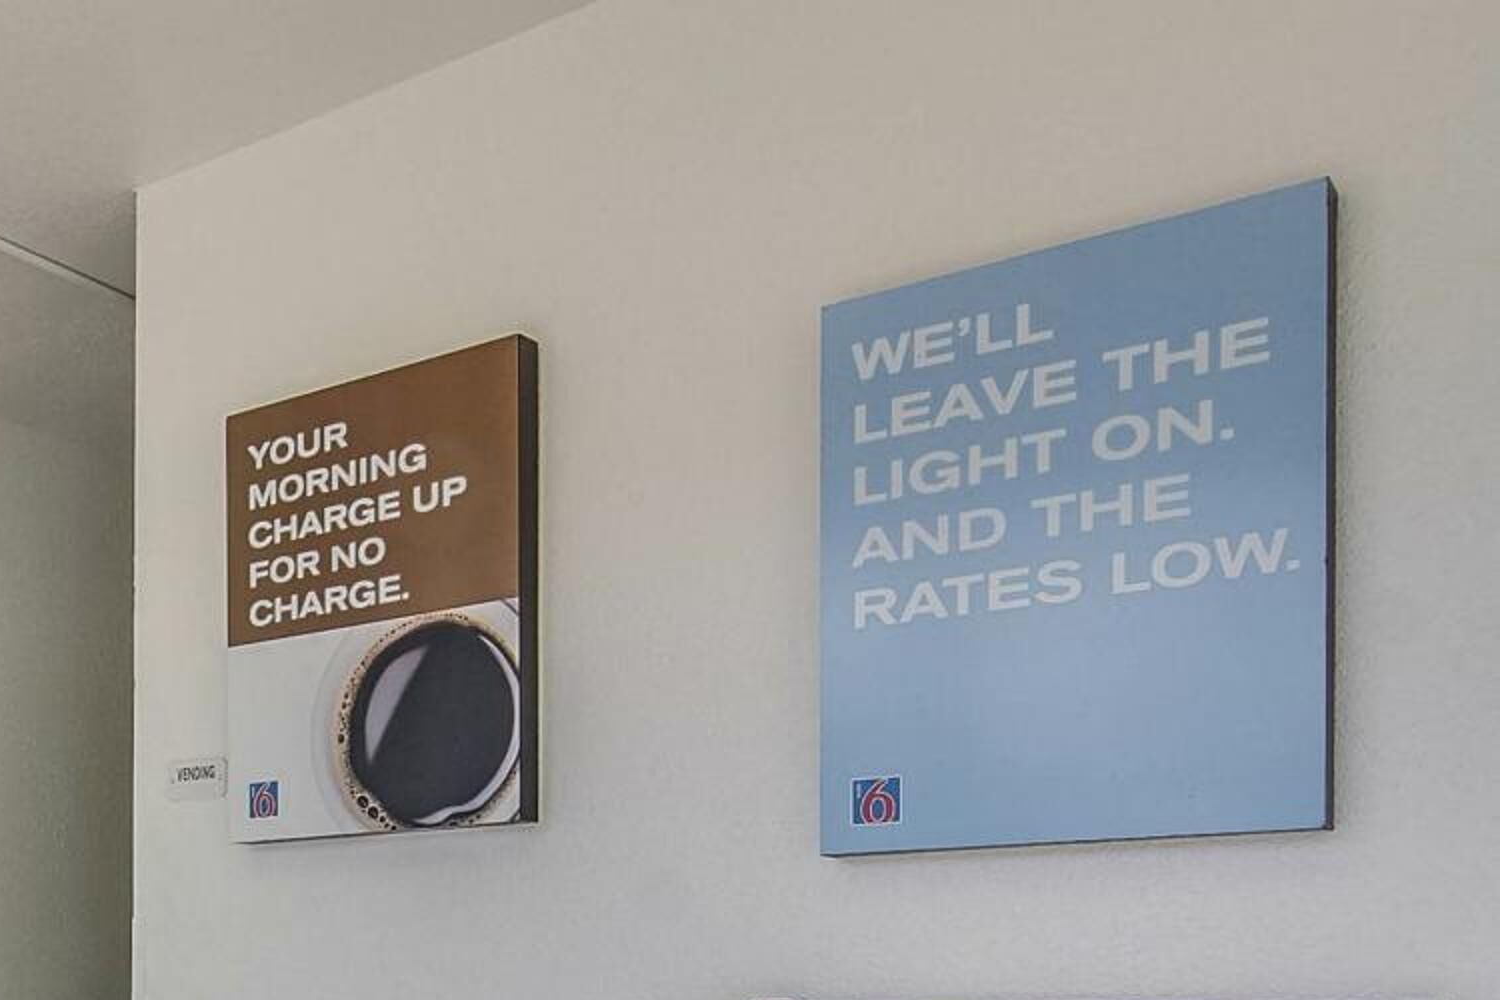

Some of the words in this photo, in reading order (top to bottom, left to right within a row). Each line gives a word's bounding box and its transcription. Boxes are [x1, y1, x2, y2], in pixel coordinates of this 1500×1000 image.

[852, 303, 1053, 380] WE'LL
[854, 360, 1077, 443] LEAVE
[1103, 316, 1269, 391] THE
[247, 423, 348, 470] YOUR
[248, 443, 428, 510] MORNING
[854, 429, 1066, 505] LIGHT
[1091, 400, 1235, 462] ON.
[248, 491, 401, 550] CHARGE
[412, 476, 468, 513] UP
[852, 507, 1007, 568] AND
[1032, 473, 1190, 537] THE
[248, 552, 321, 588] FOR
[331, 537, 386, 573] NO
[854, 560, 1082, 629] RATES
[1111, 528, 1300, 595] LOW.
[248, 573, 411, 628] CHARGE.
[177, 765, 215, 782] VENDING
